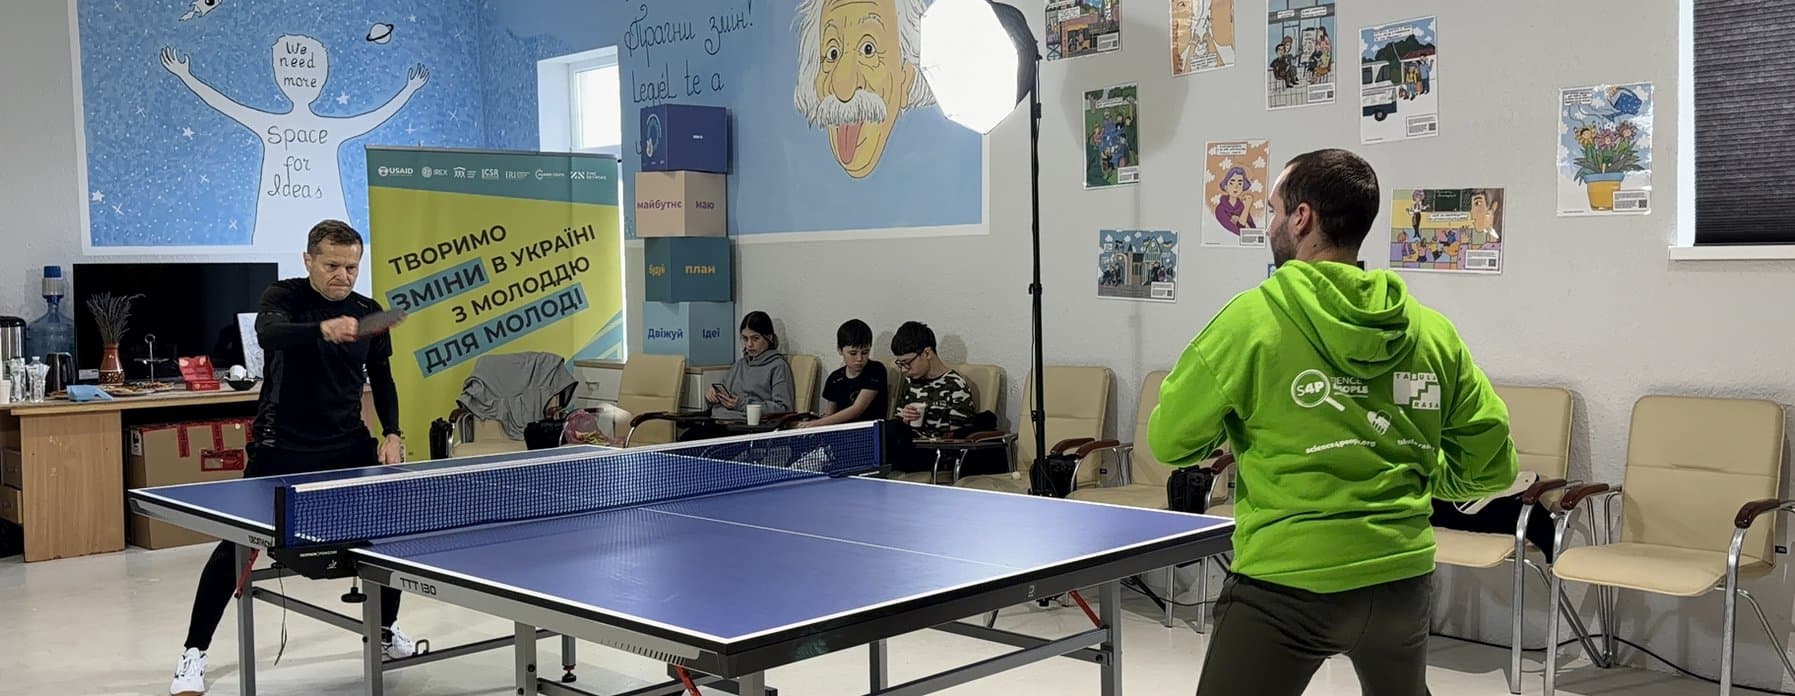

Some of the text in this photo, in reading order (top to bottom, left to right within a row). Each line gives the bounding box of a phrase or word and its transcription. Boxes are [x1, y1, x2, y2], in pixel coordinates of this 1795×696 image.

[286, 41, 307, 55] We
[280, 52, 315, 68] need
[284, 77, 317, 88] more
[683, 60, 702, 96] te
[711, 72, 725, 92] a
[267, 126, 328, 151] Space
[283, 155, 311, 183] for
[388, 167, 414, 175] USAID
[267, 174, 322, 199] Ideas
[695, 201, 715, 210] маю
[388, 225, 506, 274] ТВОРИМО
[391, 225, 596, 311] ЗМІНИ В УКРАЇНІ
[685, 265, 716, 274] план
[451, 256, 590, 323] З МОЛОДДЮ
[424, 287, 583, 373] ДЛЯ МОЛОДІ
[648, 328, 684, 340] Двіжуй
[1296, 381, 1325, 396] S4P
[400, 577, 437, 595] TTT 130
